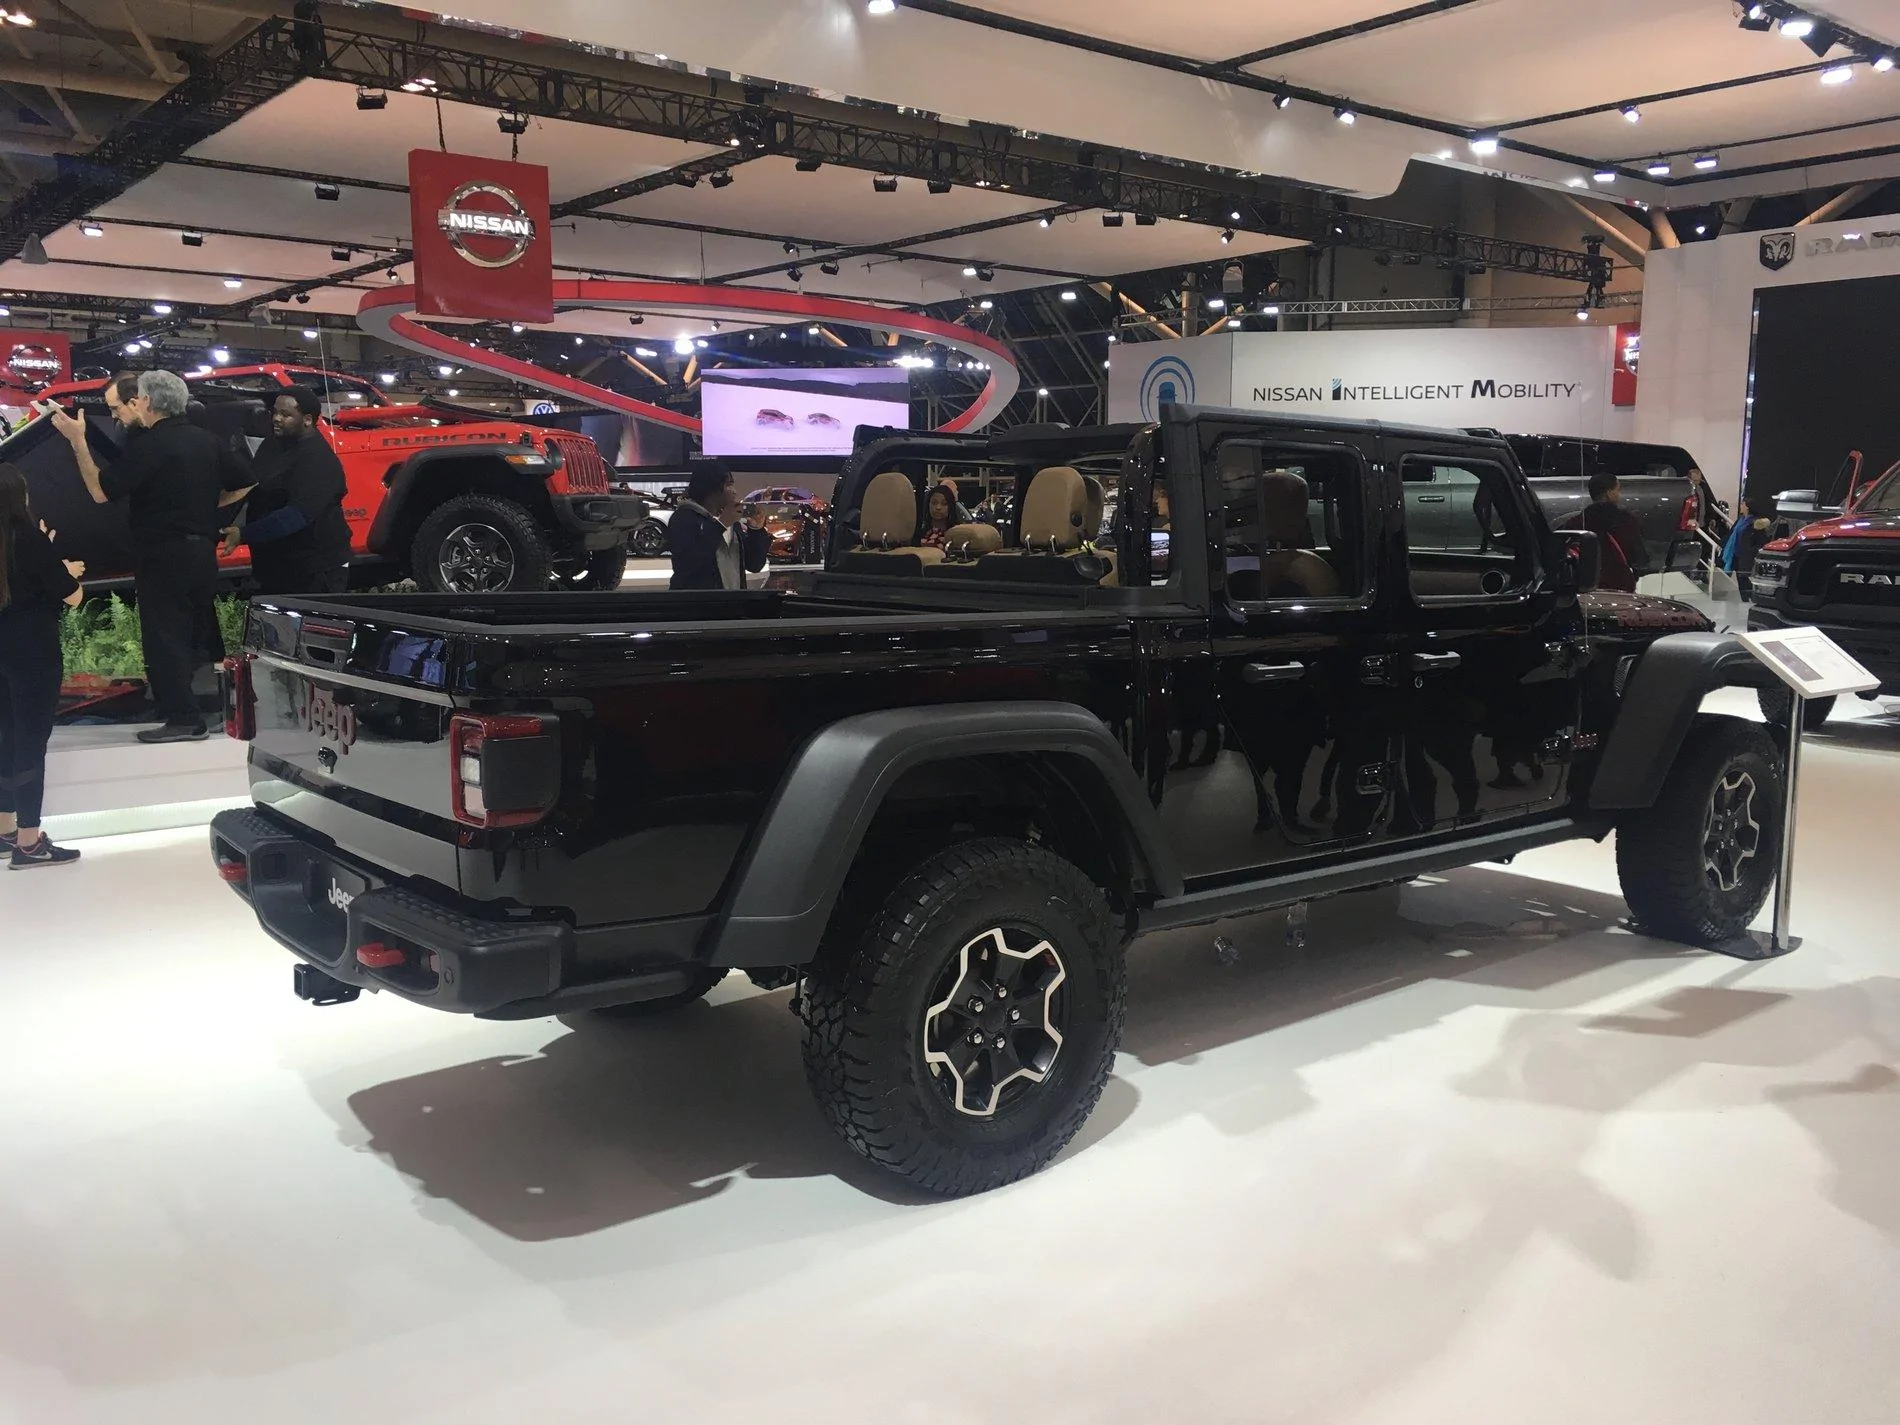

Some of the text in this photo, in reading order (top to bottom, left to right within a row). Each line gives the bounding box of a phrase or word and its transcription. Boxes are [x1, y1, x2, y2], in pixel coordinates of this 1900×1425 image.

[449, 212, 529, 235] NISSAN
[13, 359, 58, 369] NISSAN
[1253, 378, 1576, 401] NISSAN INTELLIGENT MOBILITY
[382, 433, 507, 446] RUBICON
[298, 677, 357, 755] Jeep
[327, 877, 355, 914] Jee
